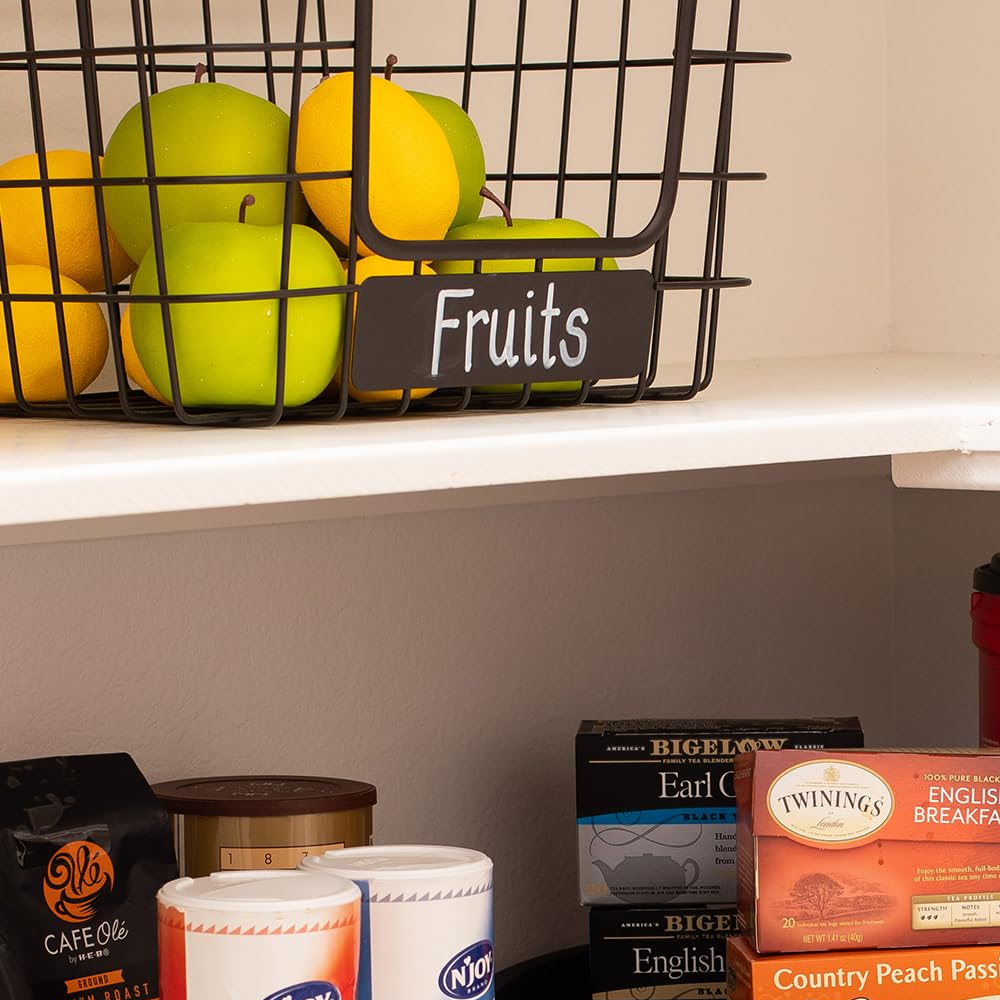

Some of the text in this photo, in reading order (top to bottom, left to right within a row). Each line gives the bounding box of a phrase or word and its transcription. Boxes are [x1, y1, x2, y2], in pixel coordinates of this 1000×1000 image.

[431, 282, 589, 377] Fruits
[658, 771, 713, 799] Earl
[949, 774, 971, 782] PURE
[973, 775, 1000, 784] BLACK
[778, 790, 884, 818] TWININGS
[714, 857, 736, 865] from
[936, 866, 946, 874] the
[969, 874, 980, 882] any
[982, 872, 997, 880] time
[782, 918, 796, 929] 20
[44, 919, 129, 955] CAFE Olé
[802, 934, 815, 944] NET
[632, 947, 726, 980] English
[78, 974, 109, 989] GROUND
[772, 967, 869, 992] Country
[876, 961, 943, 985] Peach
[467, 979, 489, 994] BRAND
